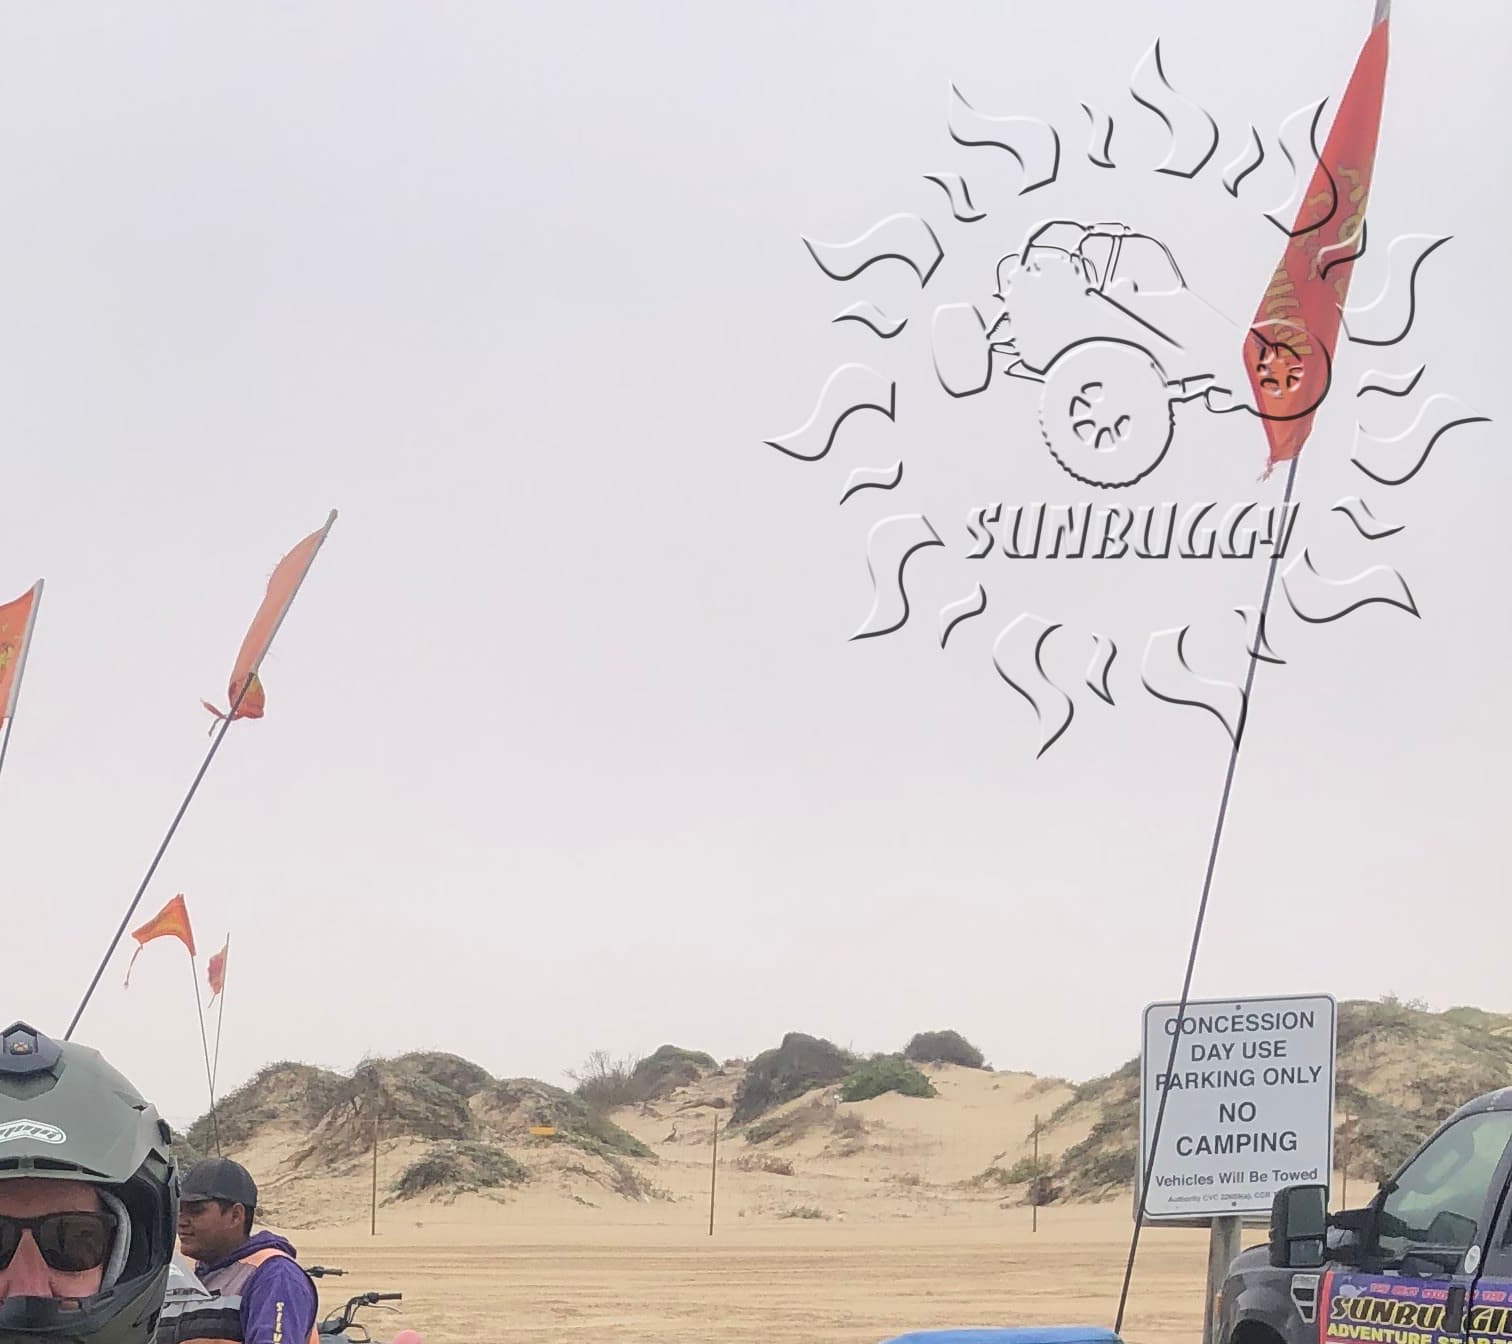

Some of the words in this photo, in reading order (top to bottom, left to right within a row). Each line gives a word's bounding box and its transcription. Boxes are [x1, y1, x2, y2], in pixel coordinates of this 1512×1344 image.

[1164, 1011, 1315, 1036] CONCESSION
[1191, 1043, 1235, 1062] DAY
[1242, 1040, 1287, 1060] USE
[1155, 1069, 1255, 1091] PARKING
[1263, 1065, 1322, 1086] ONLY
[1219, 1101, 1257, 1122] NO
[1176, 1131, 1298, 1157] CAMPING
[1155, 1173, 1214, 1187] Vehicles
[1218, 1171, 1244, 1184] Will
[1249, 1171, 1268, 1183] Be
[1272, 1168, 1318, 1181] Towed
[1329, 1295, 1512, 1336] SUNBUGI
